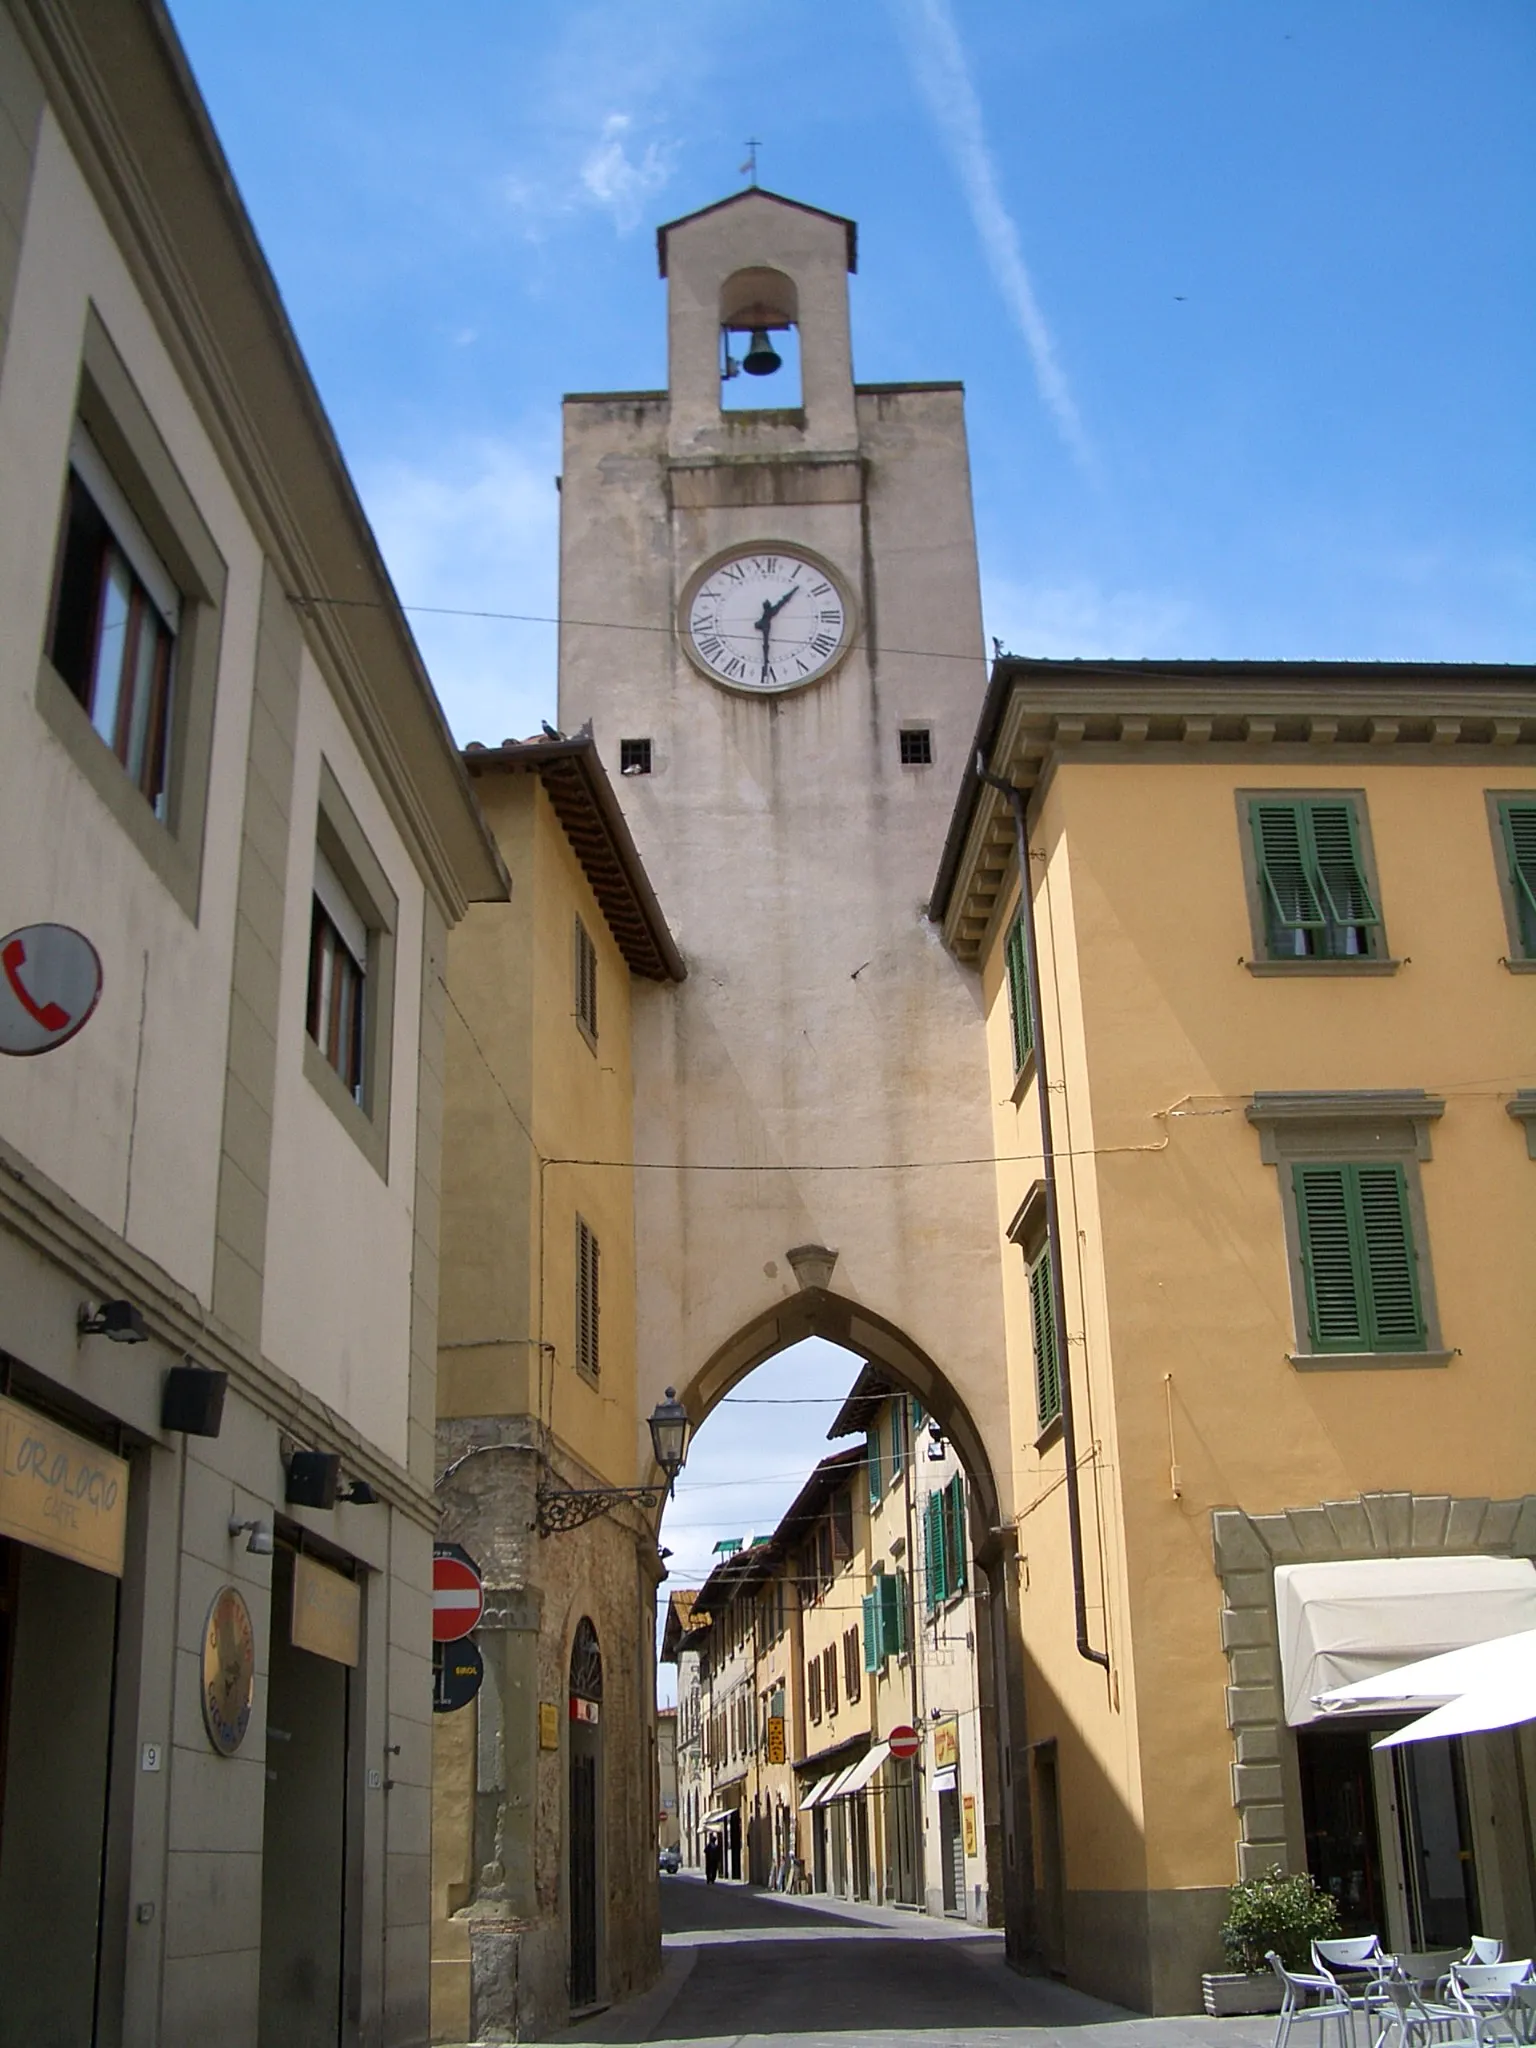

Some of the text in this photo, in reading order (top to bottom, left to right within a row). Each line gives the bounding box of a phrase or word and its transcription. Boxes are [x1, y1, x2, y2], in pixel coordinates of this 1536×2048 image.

[810, 582, 832, 598] II
[820, 609, 841, 625] III
[148, 1748, 156, 1766] 9
